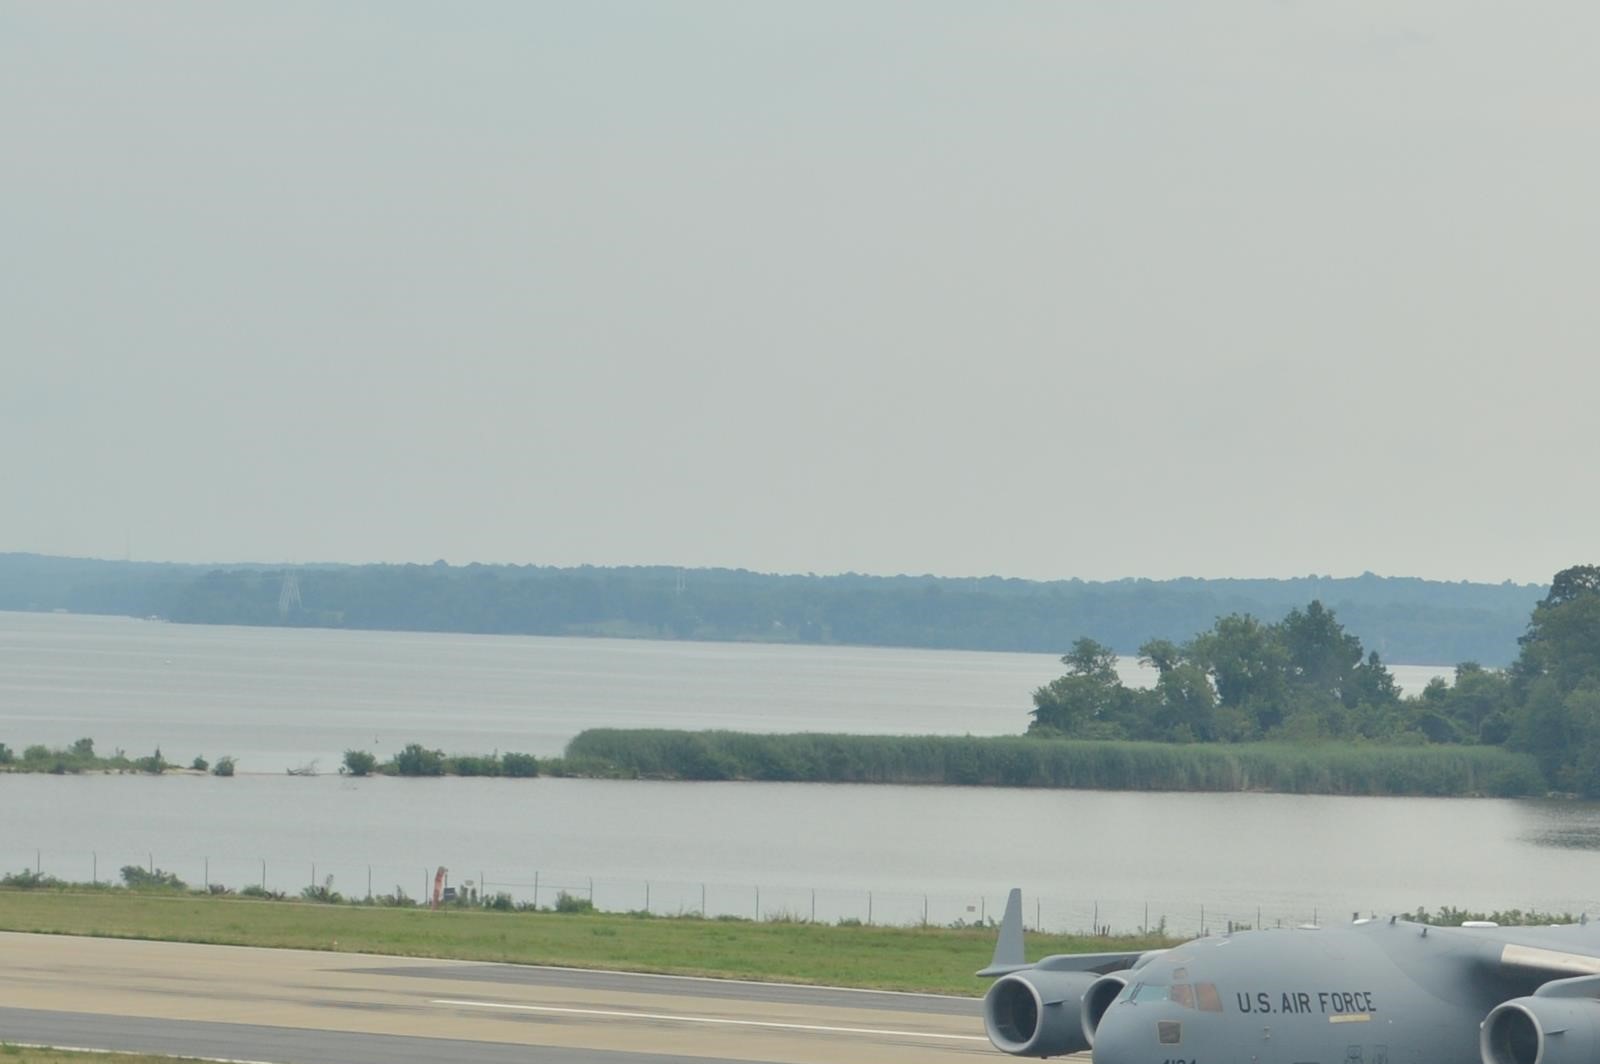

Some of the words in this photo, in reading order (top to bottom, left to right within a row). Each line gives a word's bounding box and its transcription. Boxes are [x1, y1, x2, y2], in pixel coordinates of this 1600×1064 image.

[1237, 992, 1277, 1014] U.S.
[1281, 992, 1312, 1014] AIR
[1318, 991, 1377, 1013] FORCE
